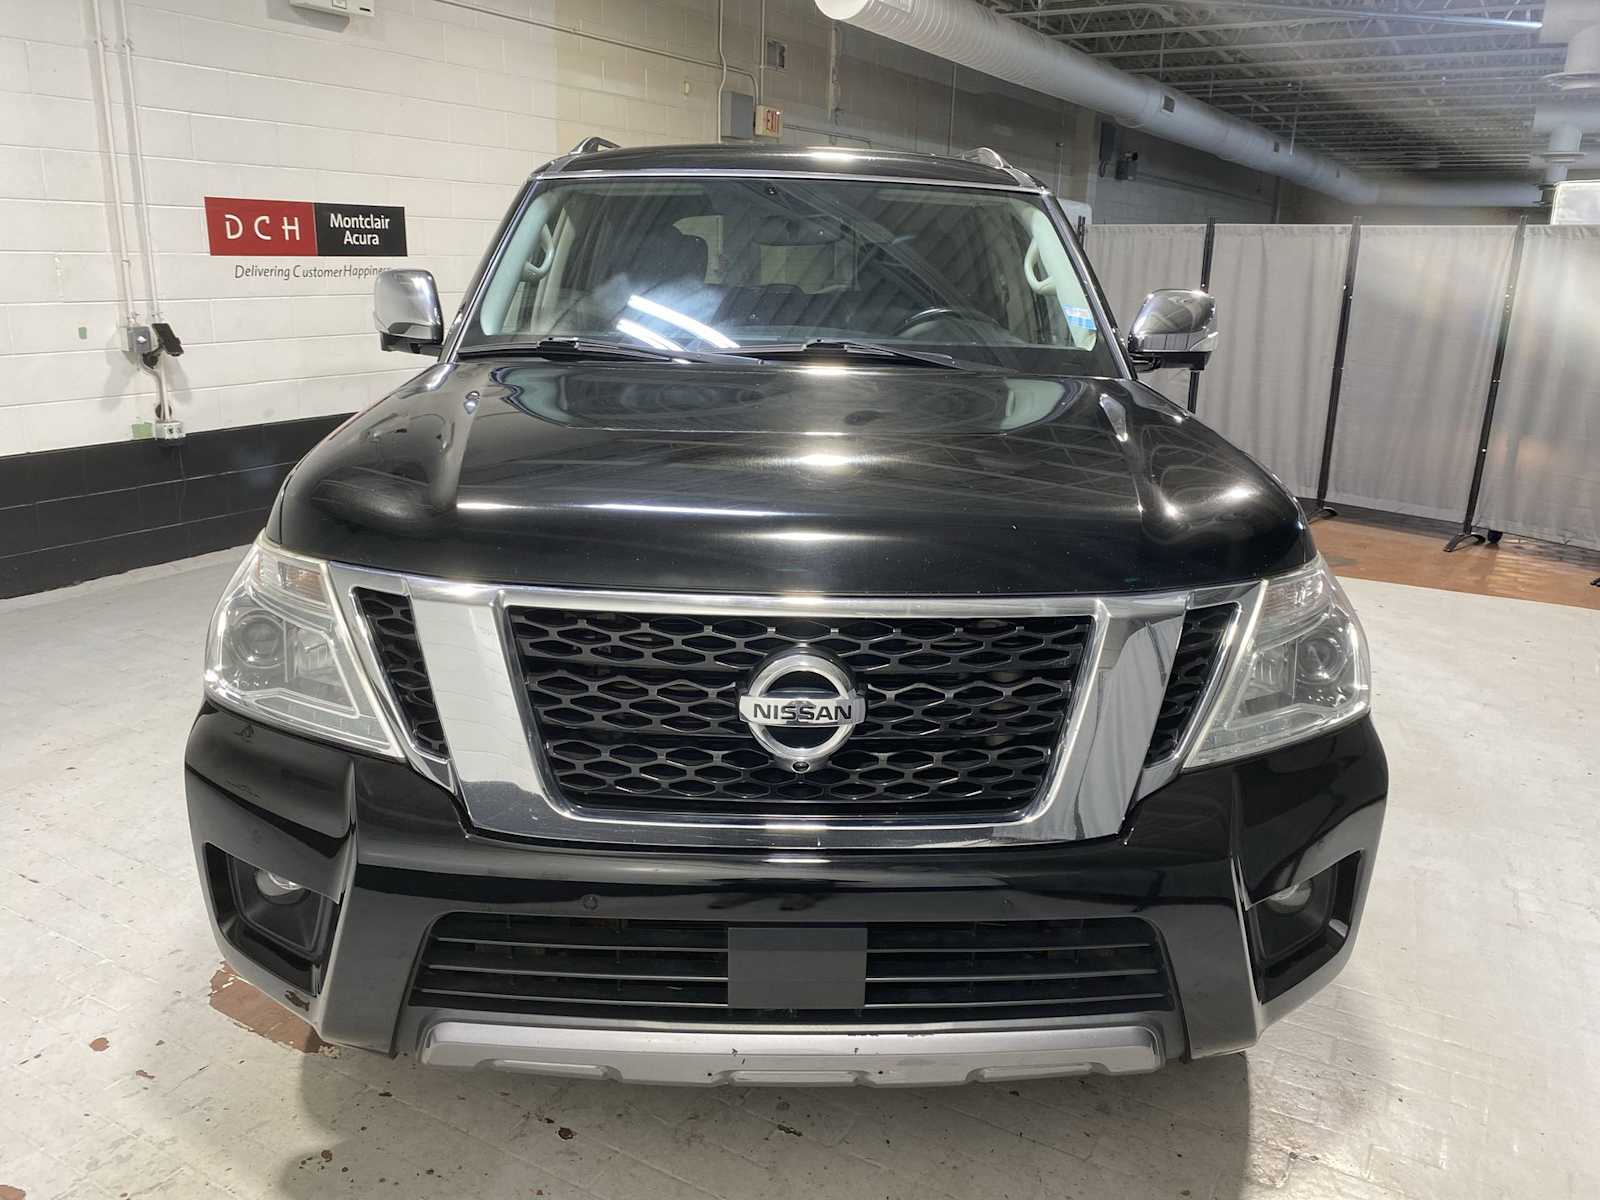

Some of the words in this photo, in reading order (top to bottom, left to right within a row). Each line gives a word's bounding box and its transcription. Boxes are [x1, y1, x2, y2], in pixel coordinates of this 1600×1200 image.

[329, 213, 390, 229] Montclair
[343, 230, 380, 245] Acura
[234, 264, 290, 281] Delivering
[293, 264, 342, 278] Customer
[343, 264, 391, 279] Happine
[753, 703, 852, 720] NISSAN
